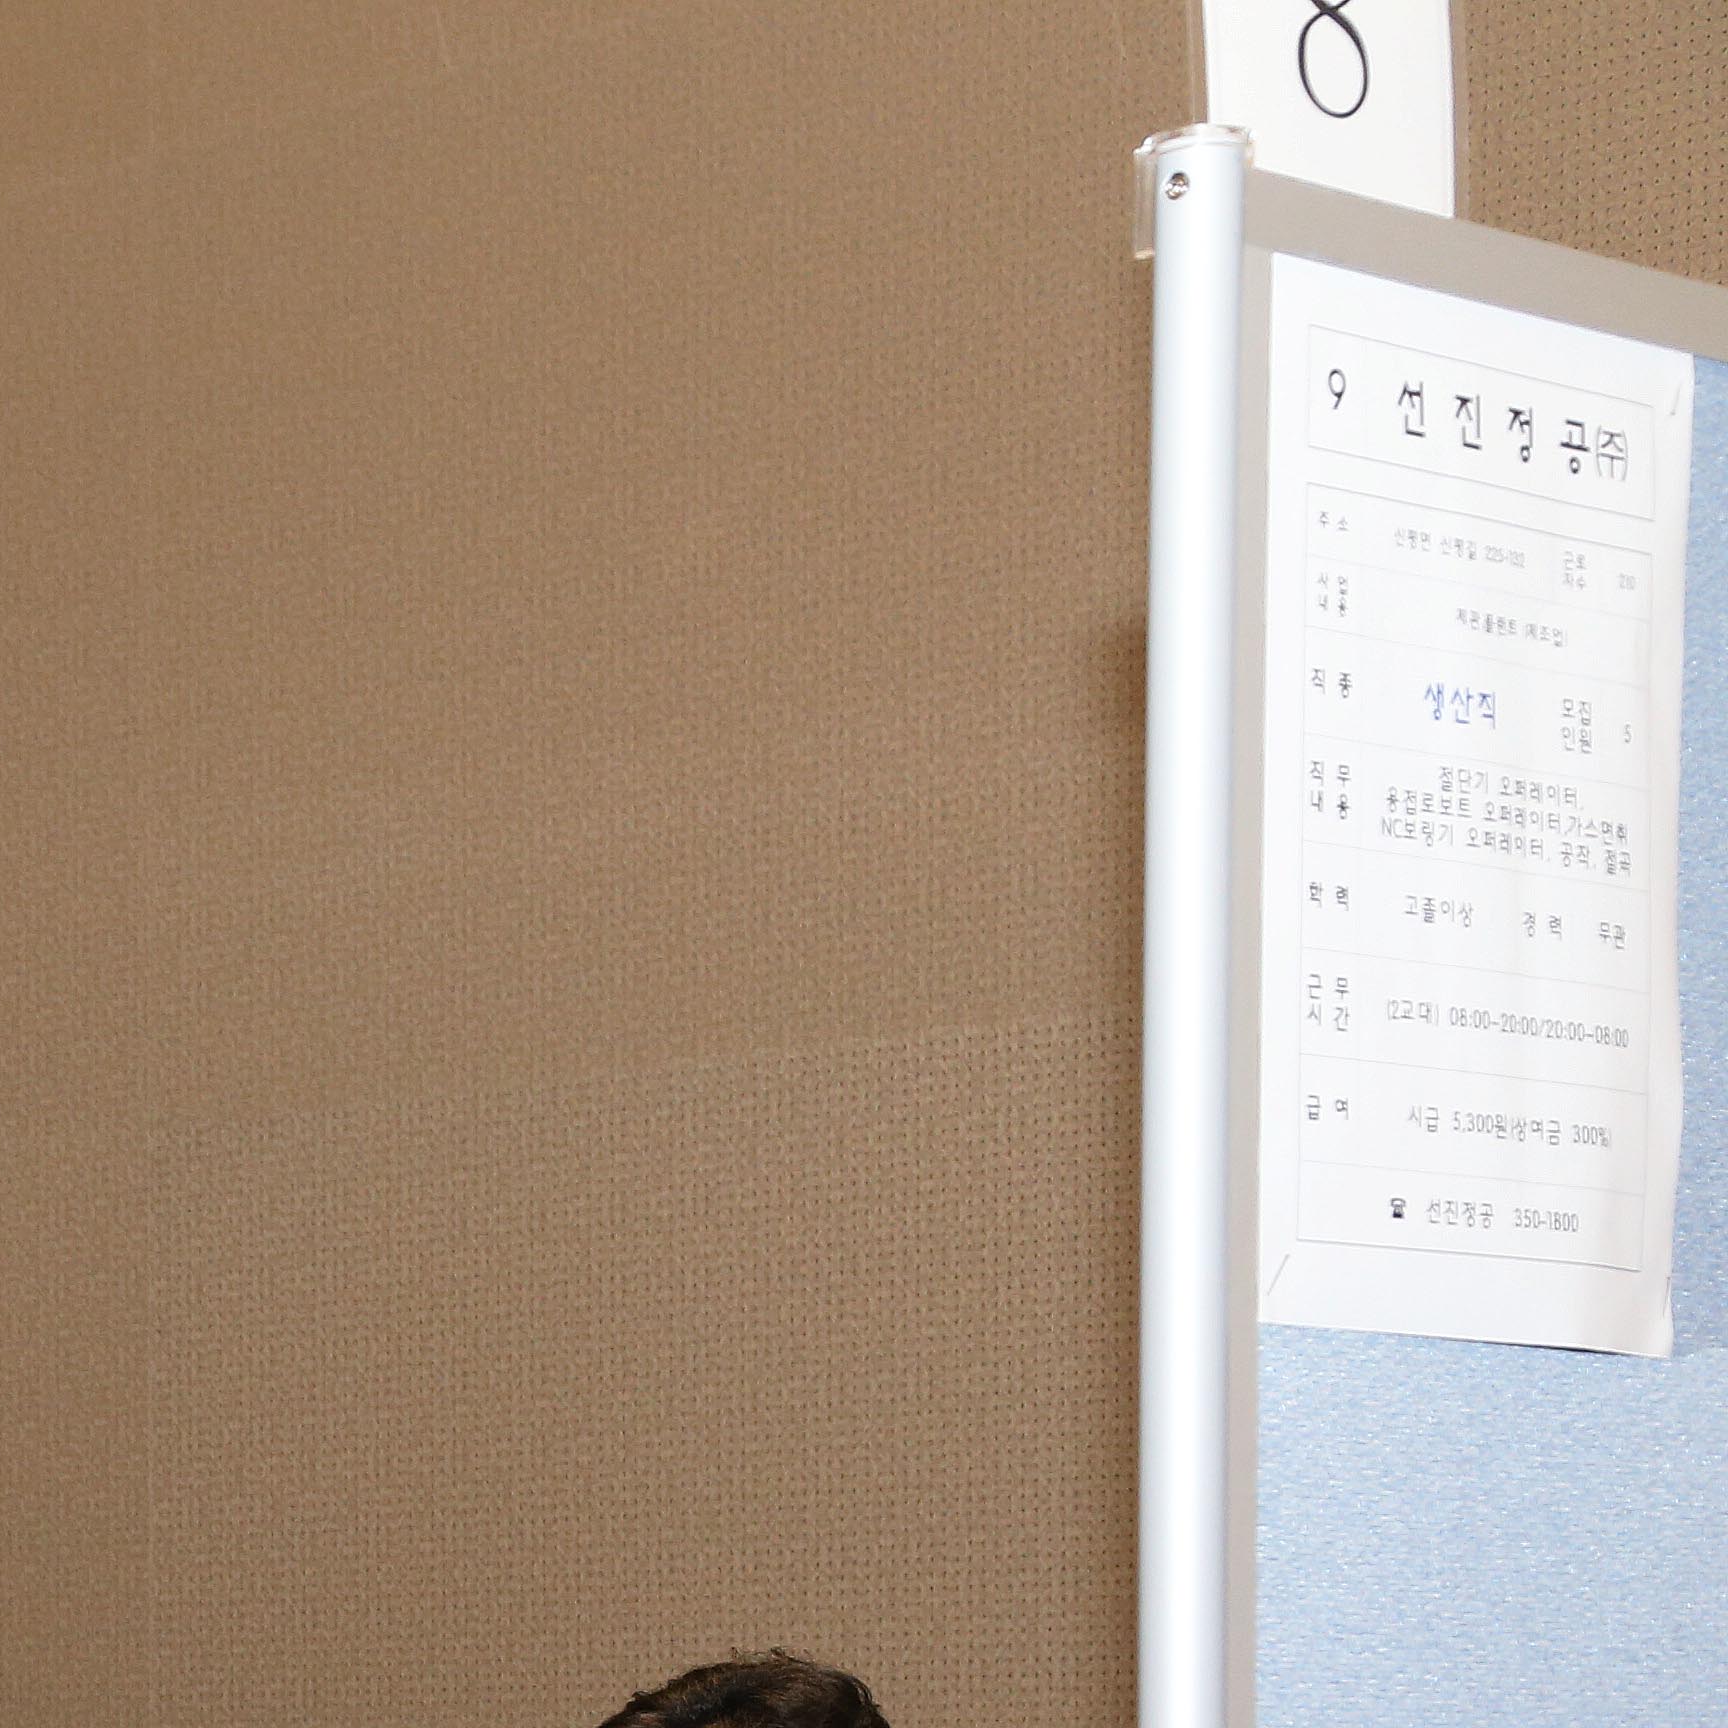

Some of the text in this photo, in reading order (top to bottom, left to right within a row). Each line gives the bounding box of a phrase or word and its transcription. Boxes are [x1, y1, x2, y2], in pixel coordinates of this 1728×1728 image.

[1297, 0, 1370, 118] 8
[1328, 368, 1346, 410] 9
[1423, 682, 1497, 730] 생산직
[1561, 698, 1593, 727] 모집
[1561, 725, 1593, 755] 인원
[1439, 765, 1490, 795] 절단기
[1404, 894, 1474, 928] 고졸이상
[1599, 920, 1626, 950] 무관
[1308, 973, 1349, 1000] 근무
[1307, 1002, 1351, 1033] 시간
[1307, 1094, 1349, 1121] 급여
[1408, 1104, 1439, 1133] 시급
[1426, 1198, 1580, 1233] 선진정공 350-1800
